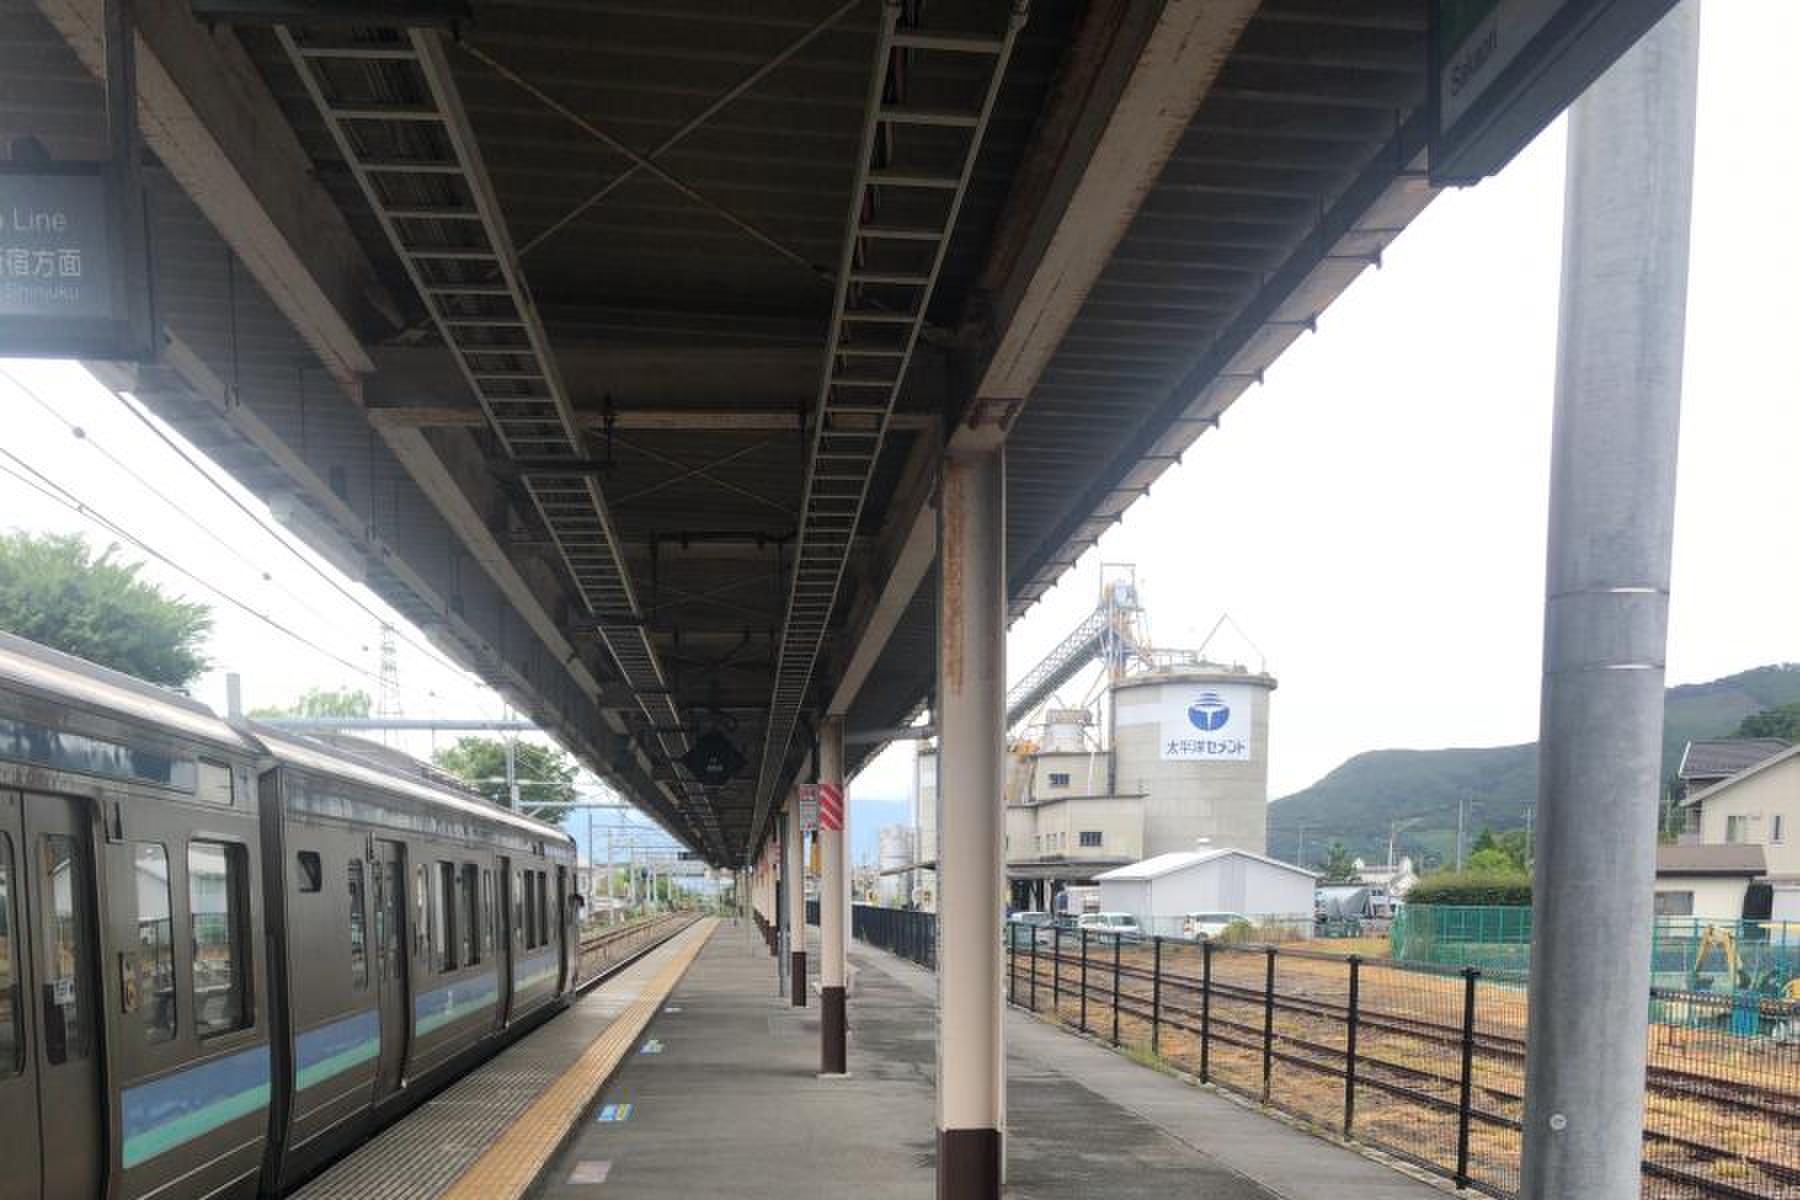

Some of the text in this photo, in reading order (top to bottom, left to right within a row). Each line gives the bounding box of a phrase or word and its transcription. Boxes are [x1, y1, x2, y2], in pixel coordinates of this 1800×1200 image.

[14, 208, 66, 231] Line
[1167, 740, 1246, 754] 太平洋セメント
